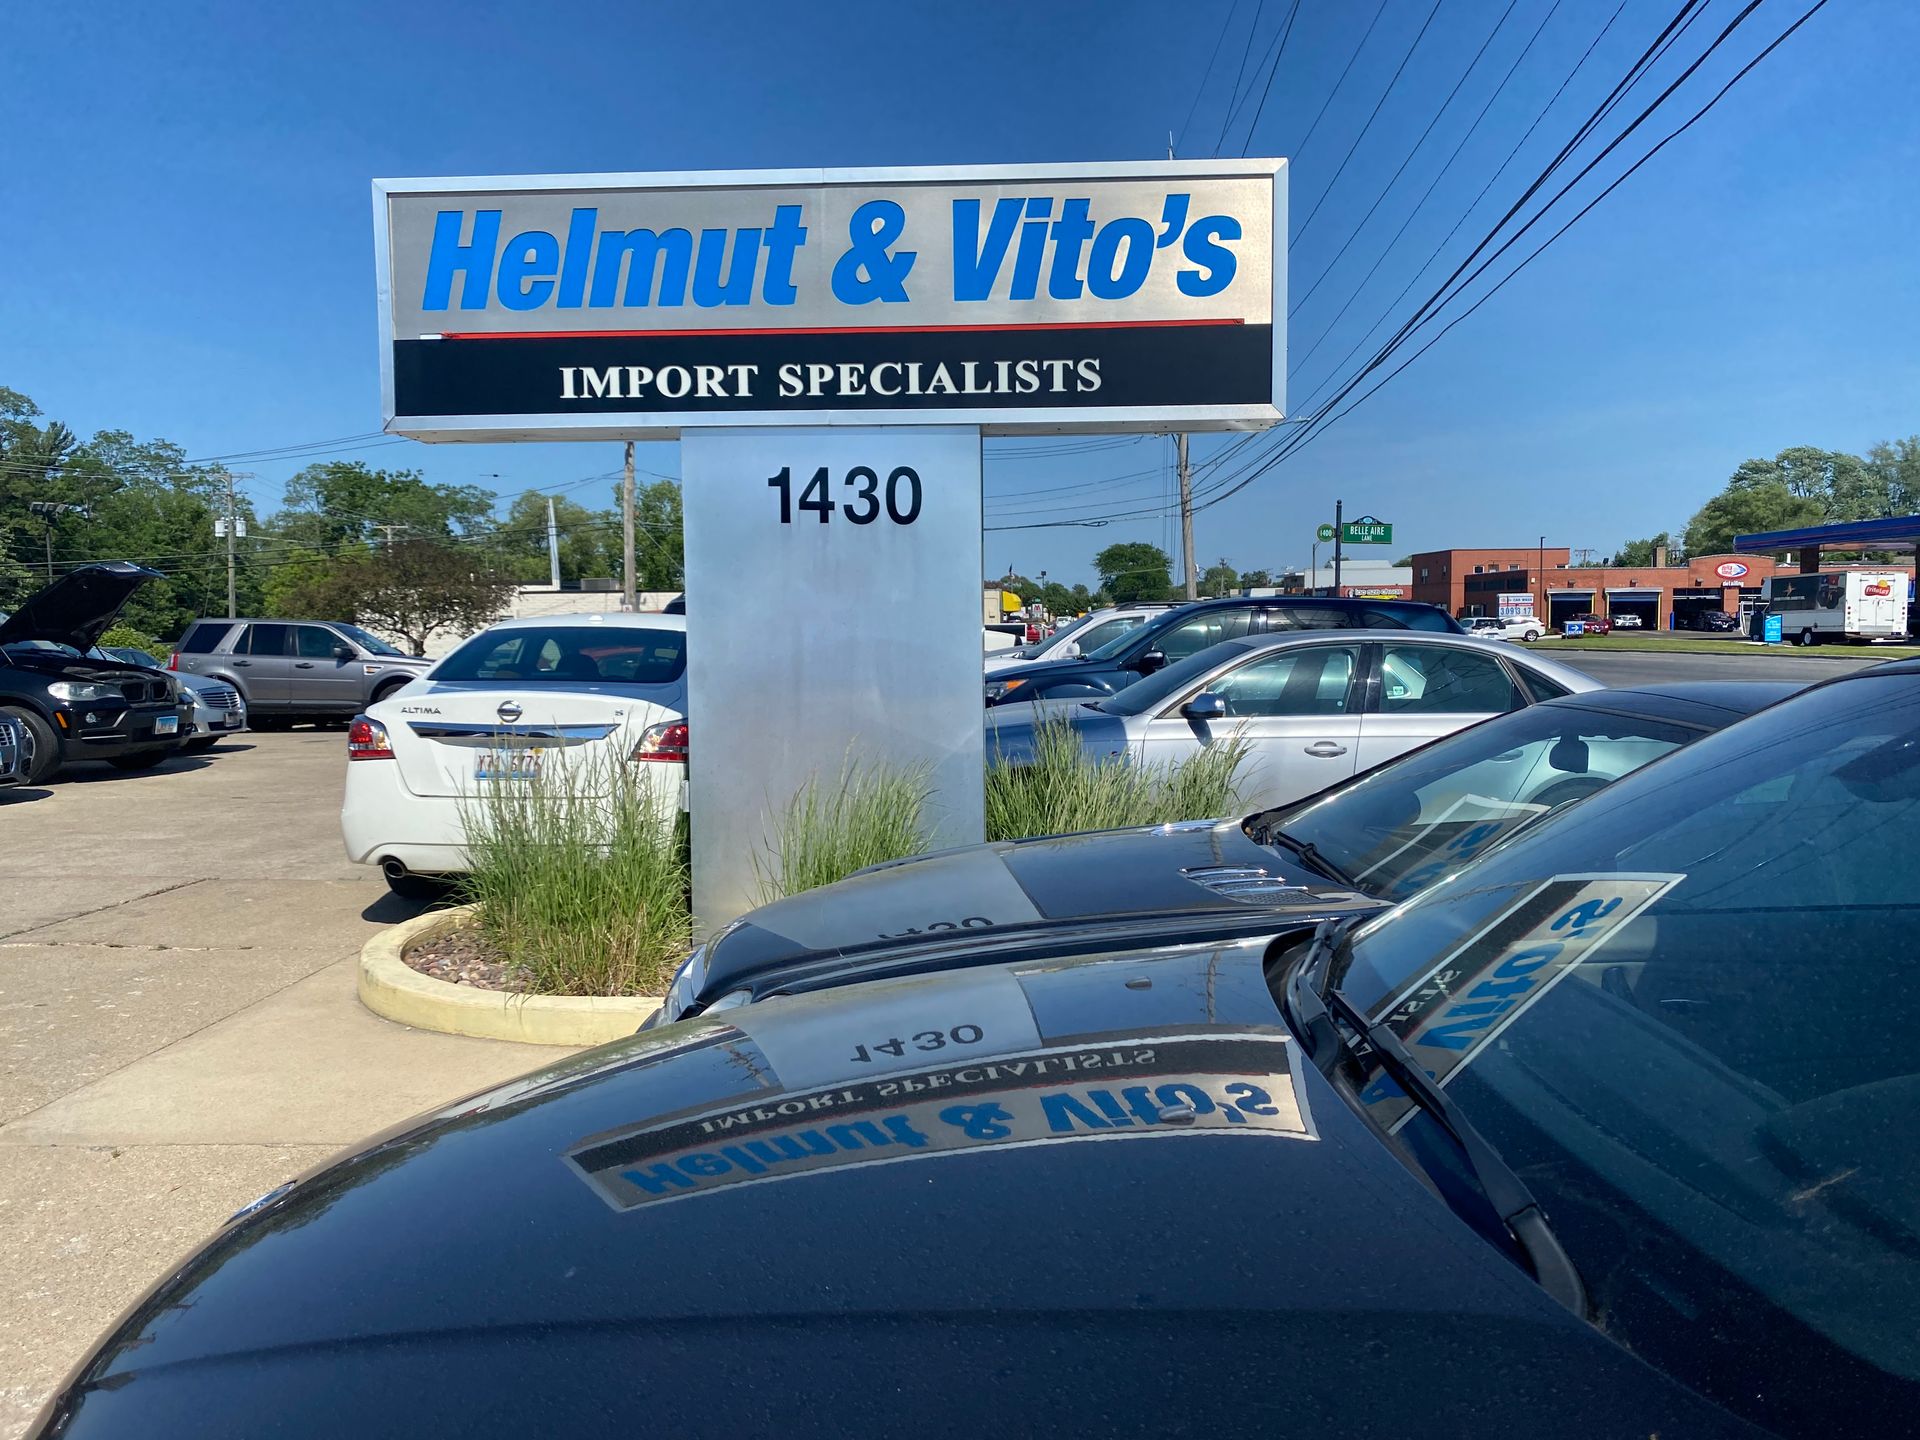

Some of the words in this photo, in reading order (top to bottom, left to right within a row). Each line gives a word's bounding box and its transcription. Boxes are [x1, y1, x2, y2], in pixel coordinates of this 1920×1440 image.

[422, 205, 808, 311] Helmut
[831, 199, 918, 305] &
[952, 193, 1242, 302] Vito's
[558, 364, 759, 399] IMPORT
[778, 358, 1102, 397] SPECIALISTS
[767, 465, 922, 525] 1430
[1350, 526, 1369, 535] BELLE
[1370, 526, 1385, 535] AIRE
